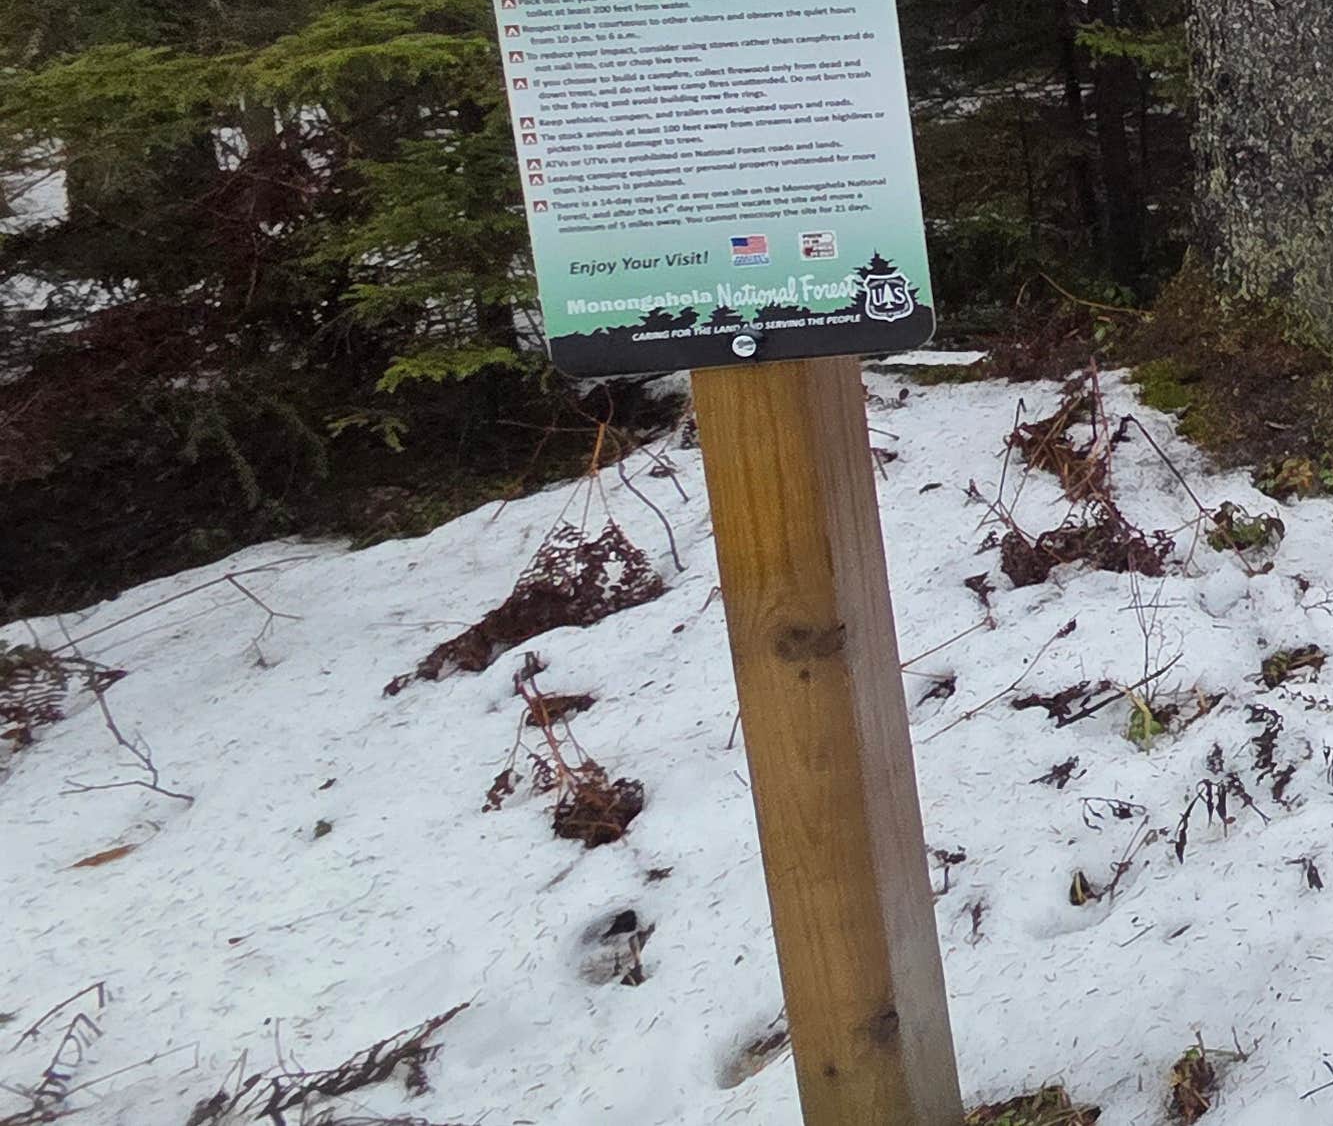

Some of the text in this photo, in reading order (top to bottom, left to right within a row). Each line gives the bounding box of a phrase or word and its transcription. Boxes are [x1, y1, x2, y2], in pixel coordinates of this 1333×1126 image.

[570, 250, 708, 277] Enjoy Your Visit!
[716, 276, 799, 307] National
[801, 274, 860, 304] Forest
[671, 328, 692, 339] FOR
[693, 326, 712, 337] THE
[807, 316, 825, 326] THE
[826, 314, 861, 325] PEOPLE
